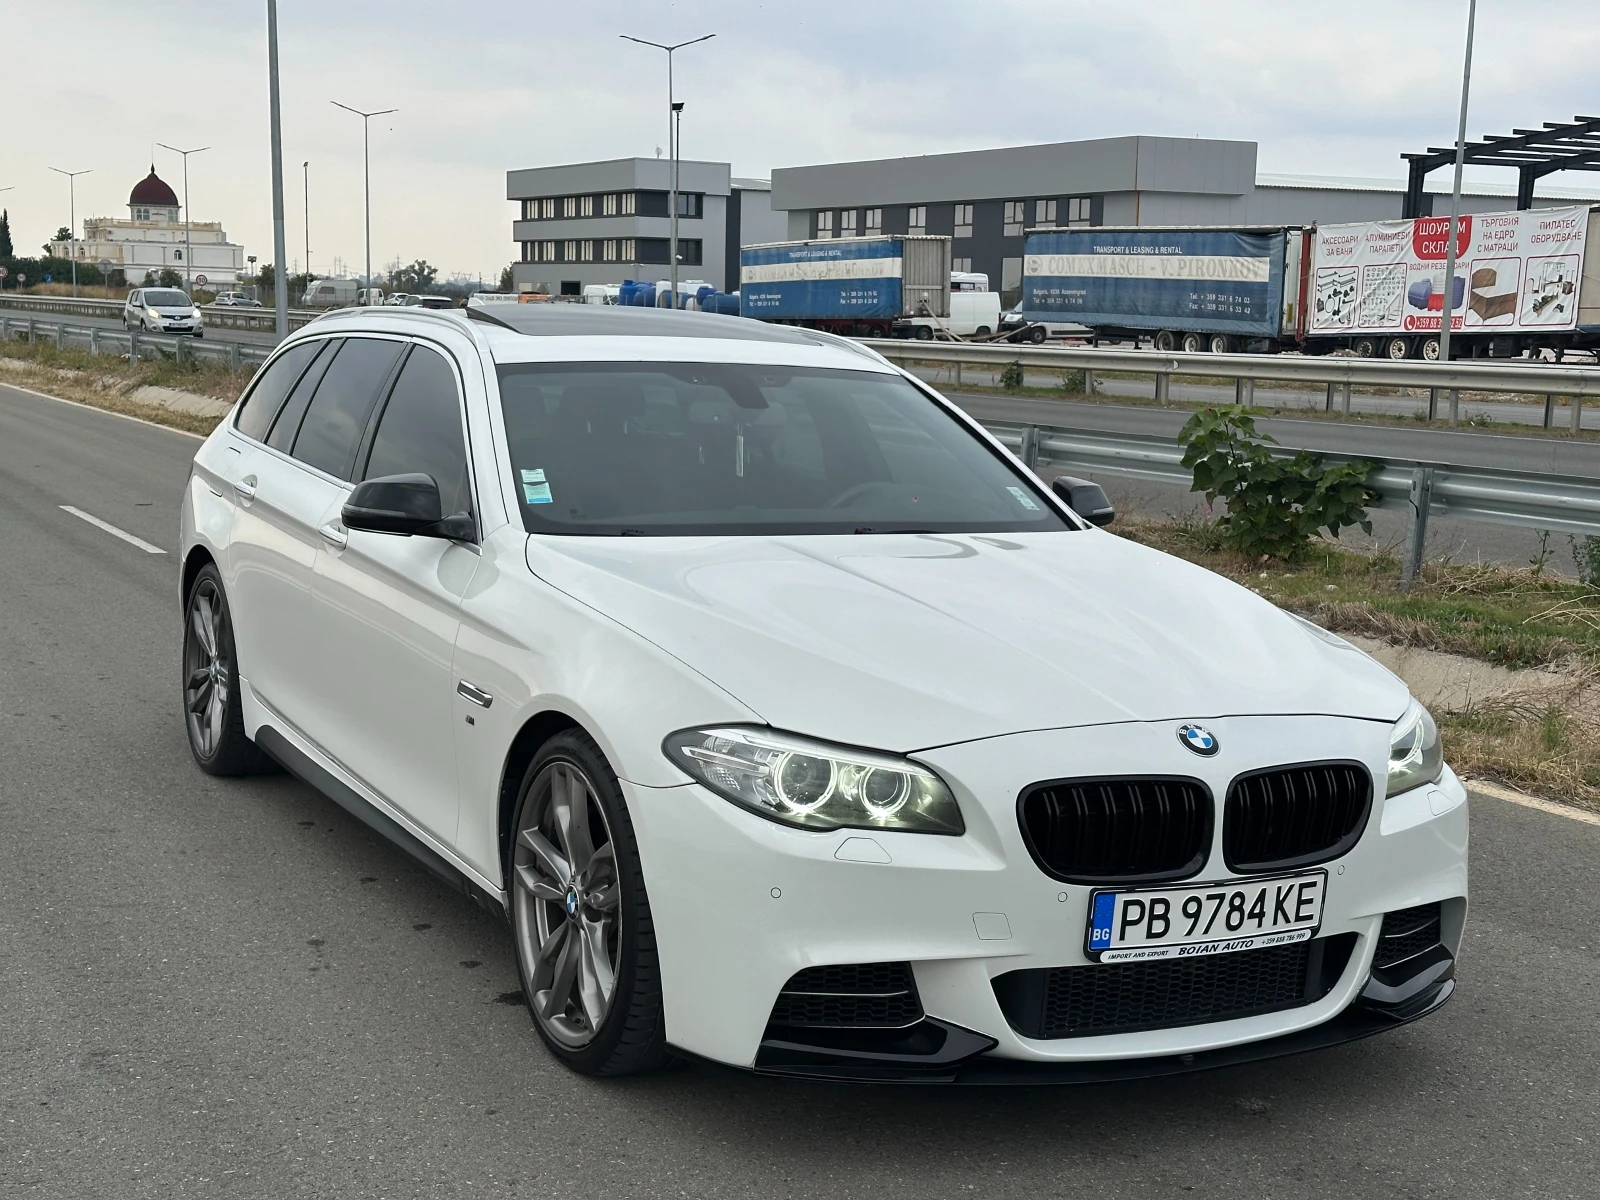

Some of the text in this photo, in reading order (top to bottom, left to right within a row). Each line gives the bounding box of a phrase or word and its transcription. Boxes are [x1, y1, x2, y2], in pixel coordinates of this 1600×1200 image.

[1419, 221, 1466, 235] ШОУРМ
[1481, 217, 1519, 228] ТЪРГОВИЯ
[1540, 219, 1576, 230] ПИЛАТЕС
[1483, 229, 1515, 240] НА ЕДРО
[1530, 231, 1583, 244] ОБОРУДВАНЕ
[1321, 236, 1359, 245] АКСЕСОАРИ
[1093, 245, 1125, 254] TRANSPORT
[1130, 246, 1154, 254] LEASING
[1160, 246, 1183, 254] RENTAL
[1326, 247, 1353, 256] ЗА БАНЯ
[1477, 242, 1518, 253] С МАТРАЦИ
[1409, 262, 1430, 271] ВОДНИ
[1118, 880, 1318, 941] PB 9784 KE
[1092, 928, 1110, 941] BG
[1107, 952, 1132, 960] IMPORT
[1178, 943, 1221, 956] BOIAN
[1221, 939, 1254, 952] AUTO
